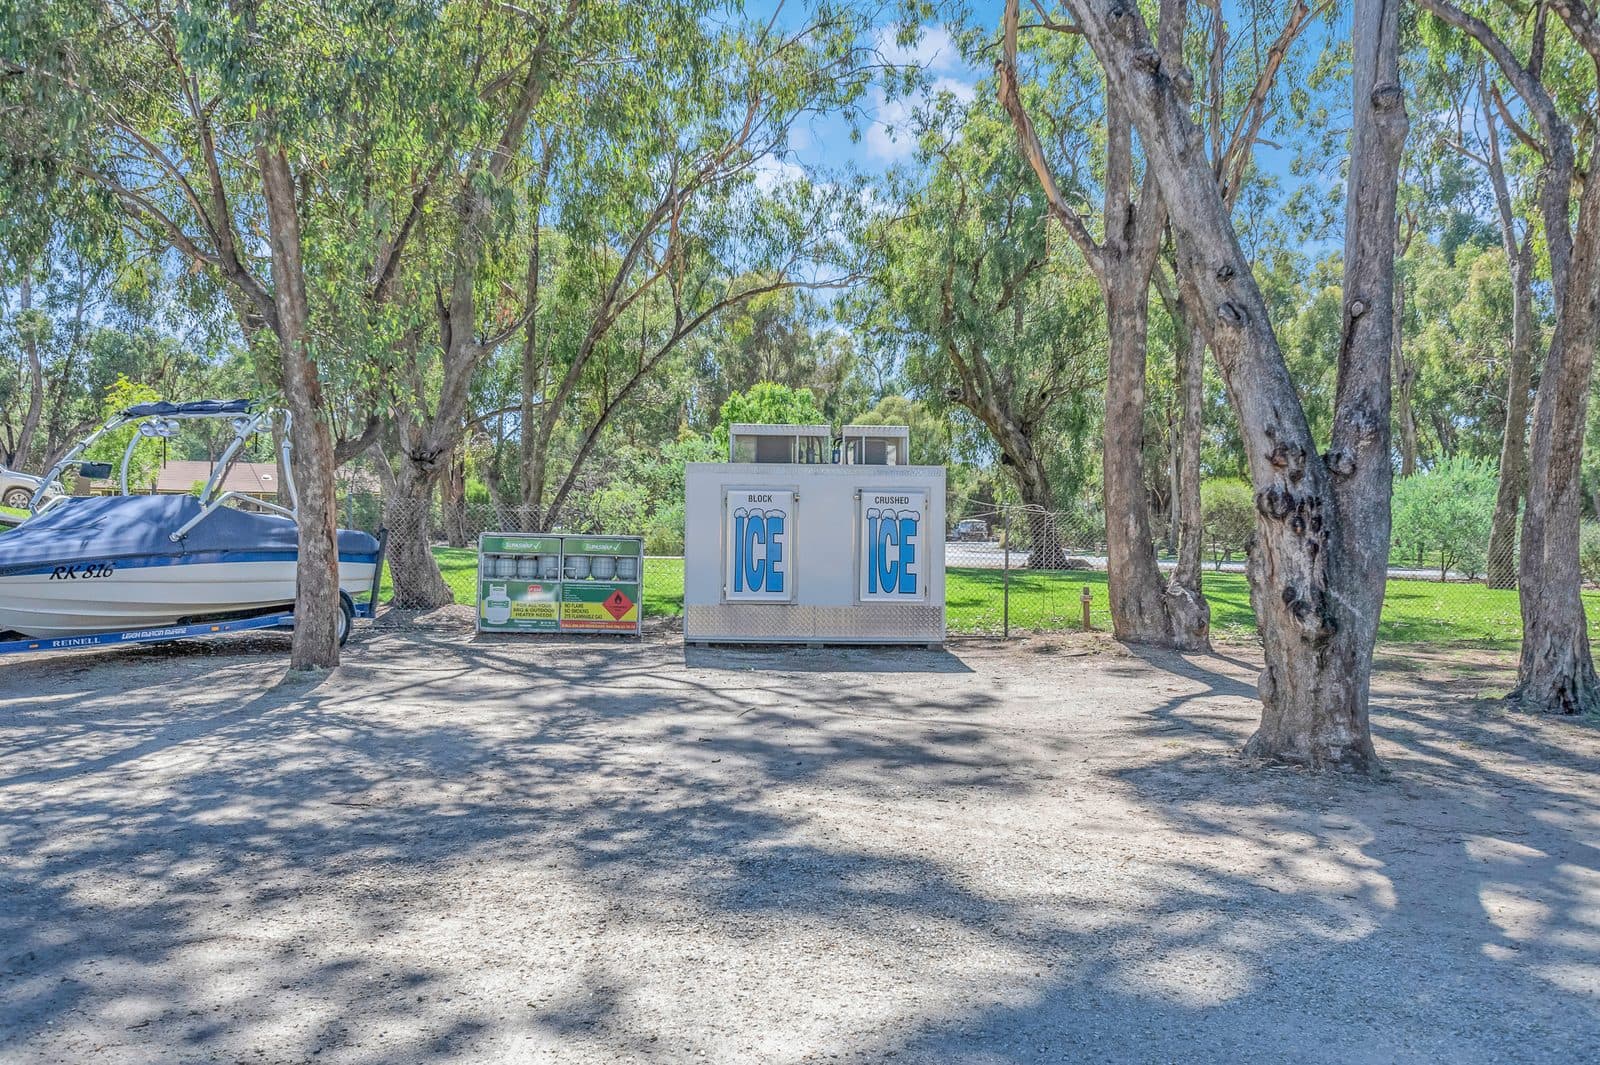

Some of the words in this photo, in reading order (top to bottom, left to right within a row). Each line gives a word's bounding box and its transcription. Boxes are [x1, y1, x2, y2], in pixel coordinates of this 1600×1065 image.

[748, 494, 773, 503] BLOCK
[874, 496, 910, 505] CRUSHED
[734, 507, 786, 592] ICE
[867, 507, 920, 594] ICE
[49, 565, 80, 580] RK
[82, 562, 116, 579] 816
[52, 637, 101, 647] REINELL
